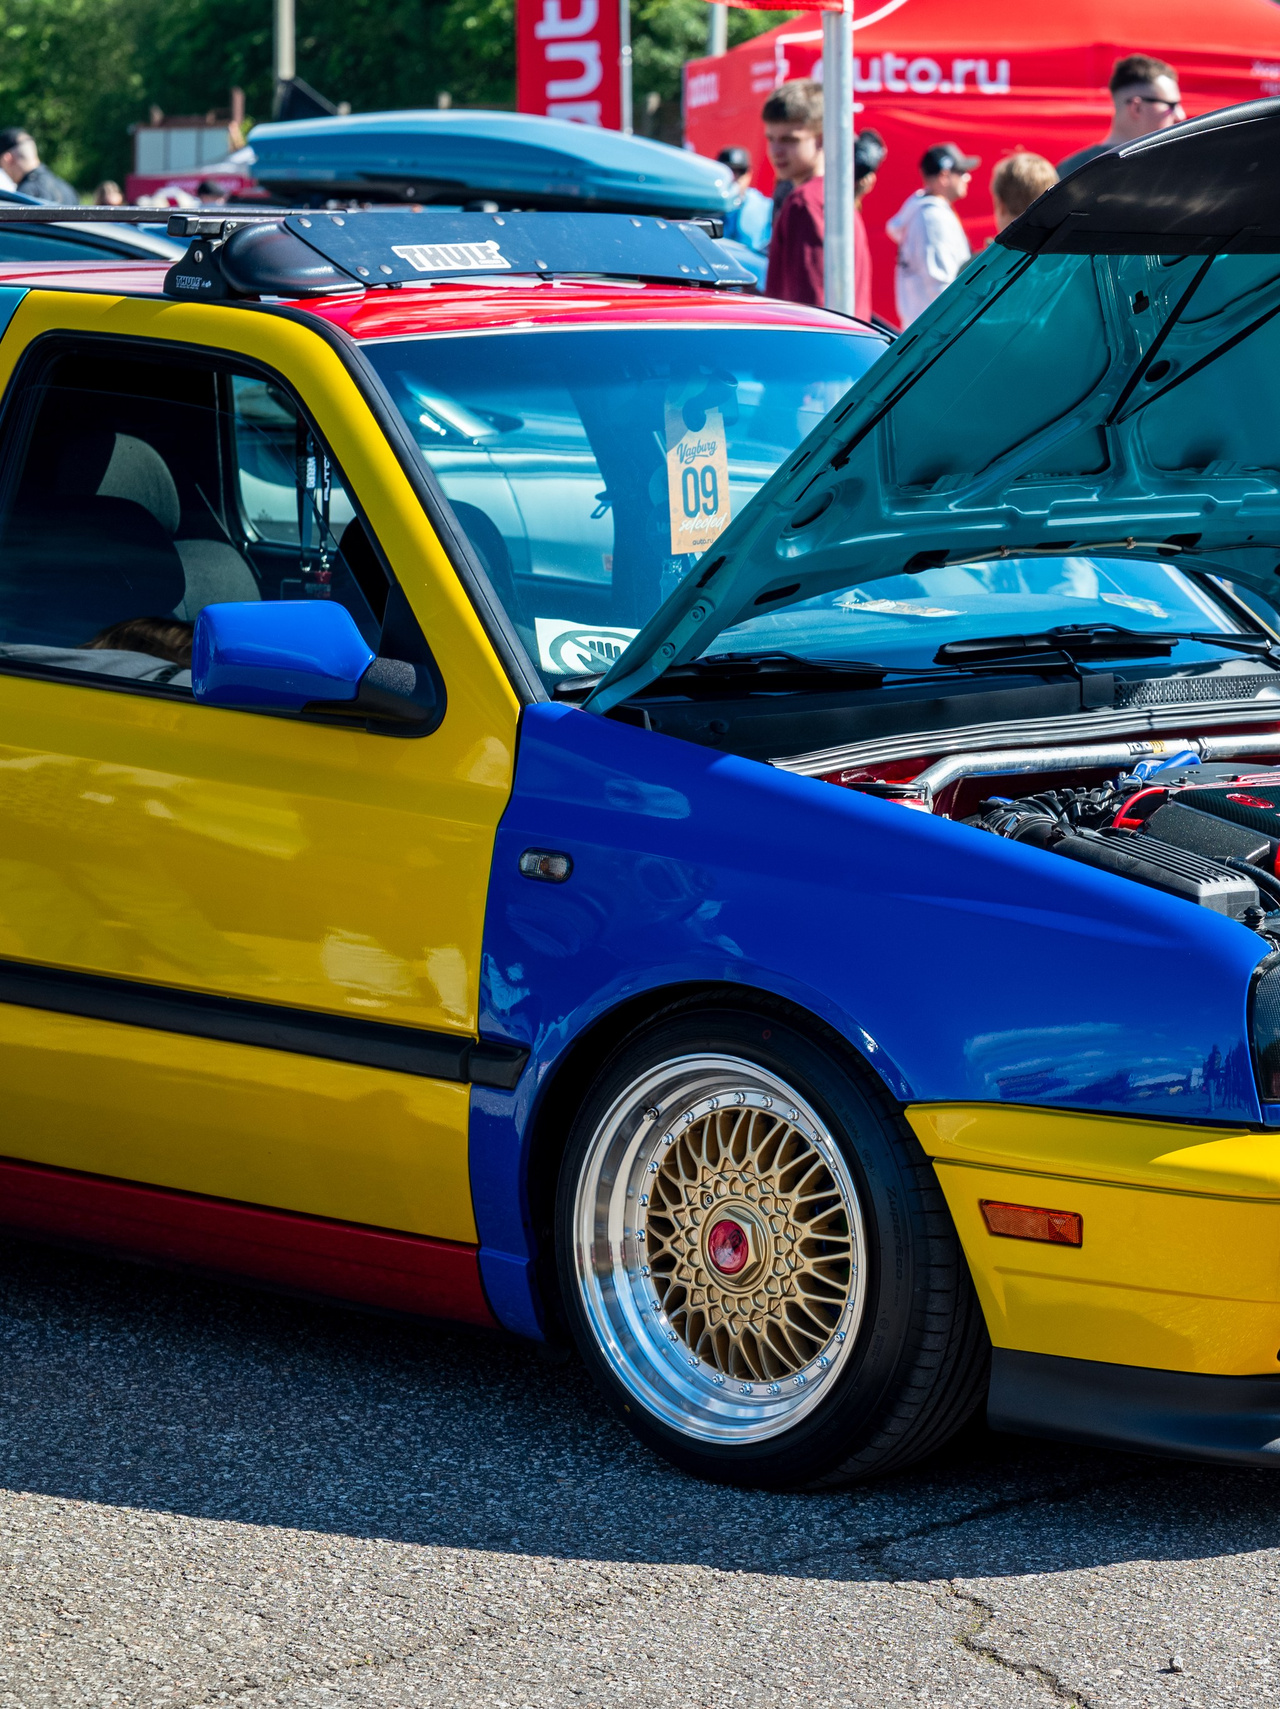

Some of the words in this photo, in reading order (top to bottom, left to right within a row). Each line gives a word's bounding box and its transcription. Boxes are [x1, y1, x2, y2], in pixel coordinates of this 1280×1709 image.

[395, 243, 508, 269] THULE
[677, 440, 718, 465] Vagburg
[682, 465, 719, 518] 09
[679, 510, 727, 534] selected
[692, 537, 714, 546] auto.ru
[886, 1185, 904, 1280] ZuperEco
